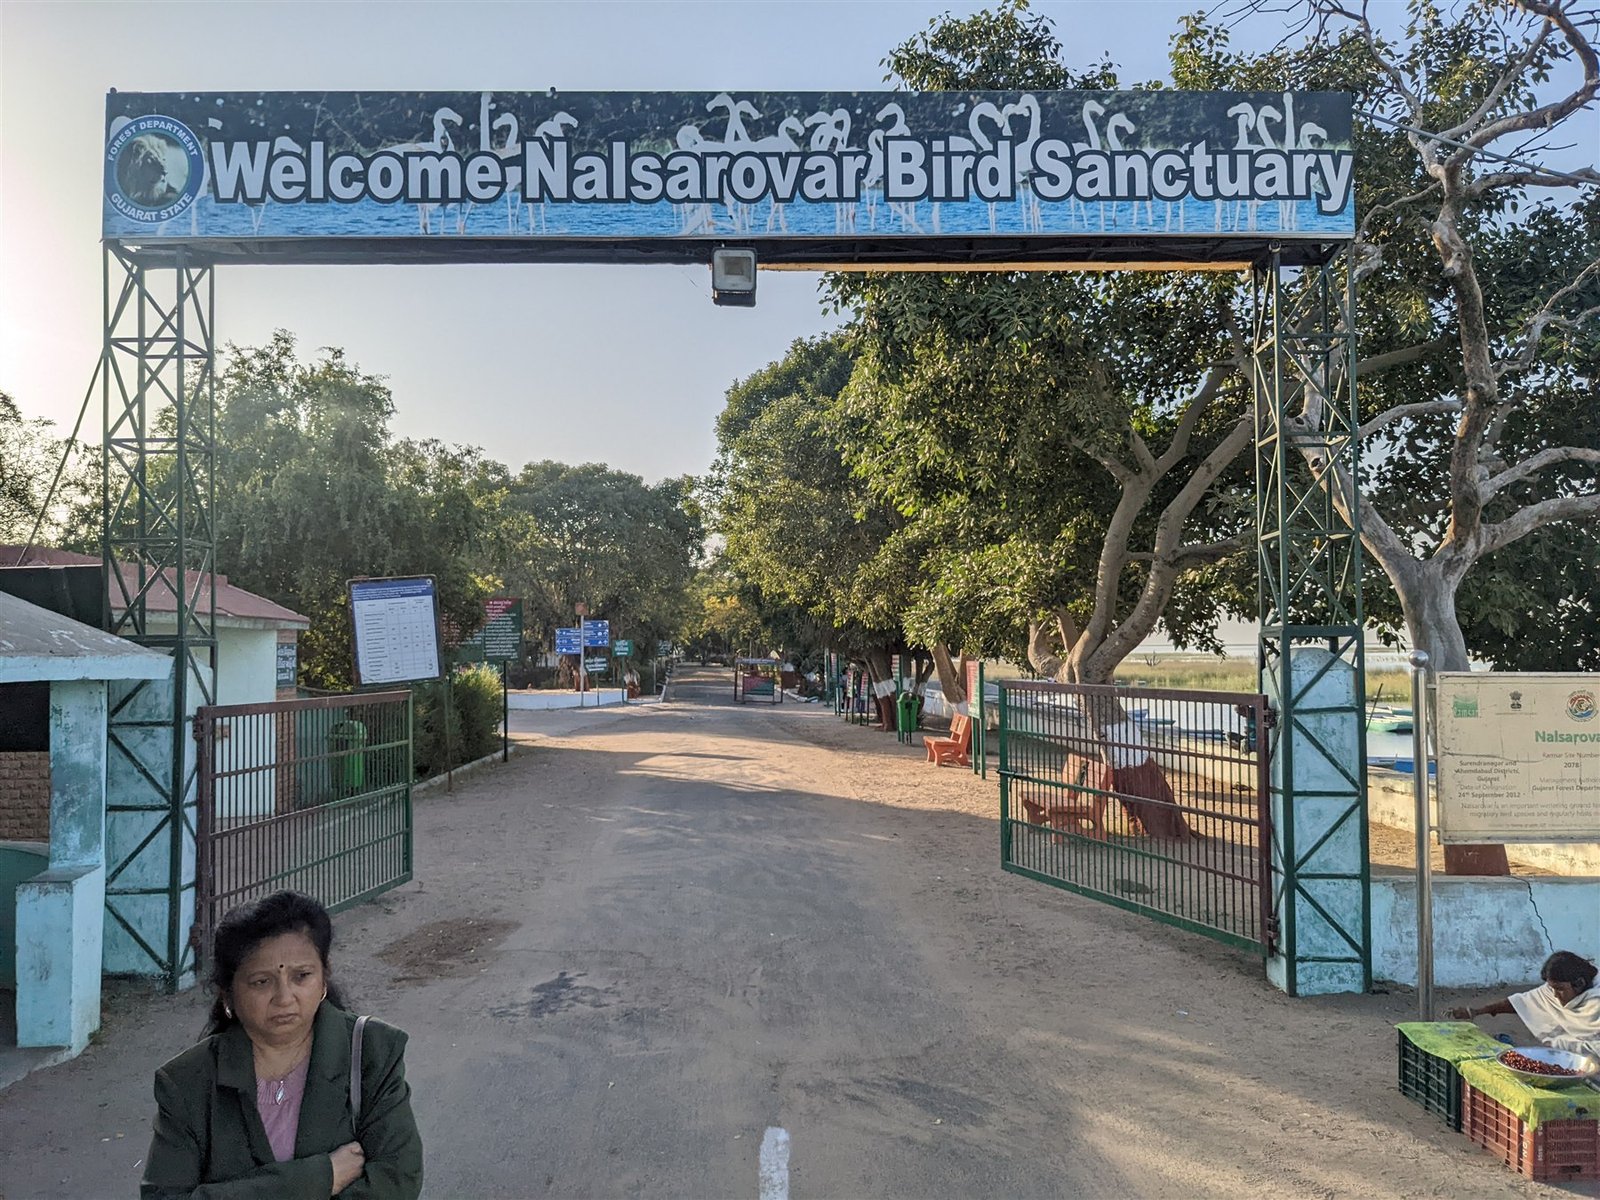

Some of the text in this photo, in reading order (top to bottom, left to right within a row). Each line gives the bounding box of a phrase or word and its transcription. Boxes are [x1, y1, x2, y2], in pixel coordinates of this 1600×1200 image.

[108, 120, 198, 161] FOREST DEPARTMENT
[210, 138, 1353, 212] Welcome Nalsarovar Bird Sanctuary
[111, 192, 193, 221] GUJARAT STATE
